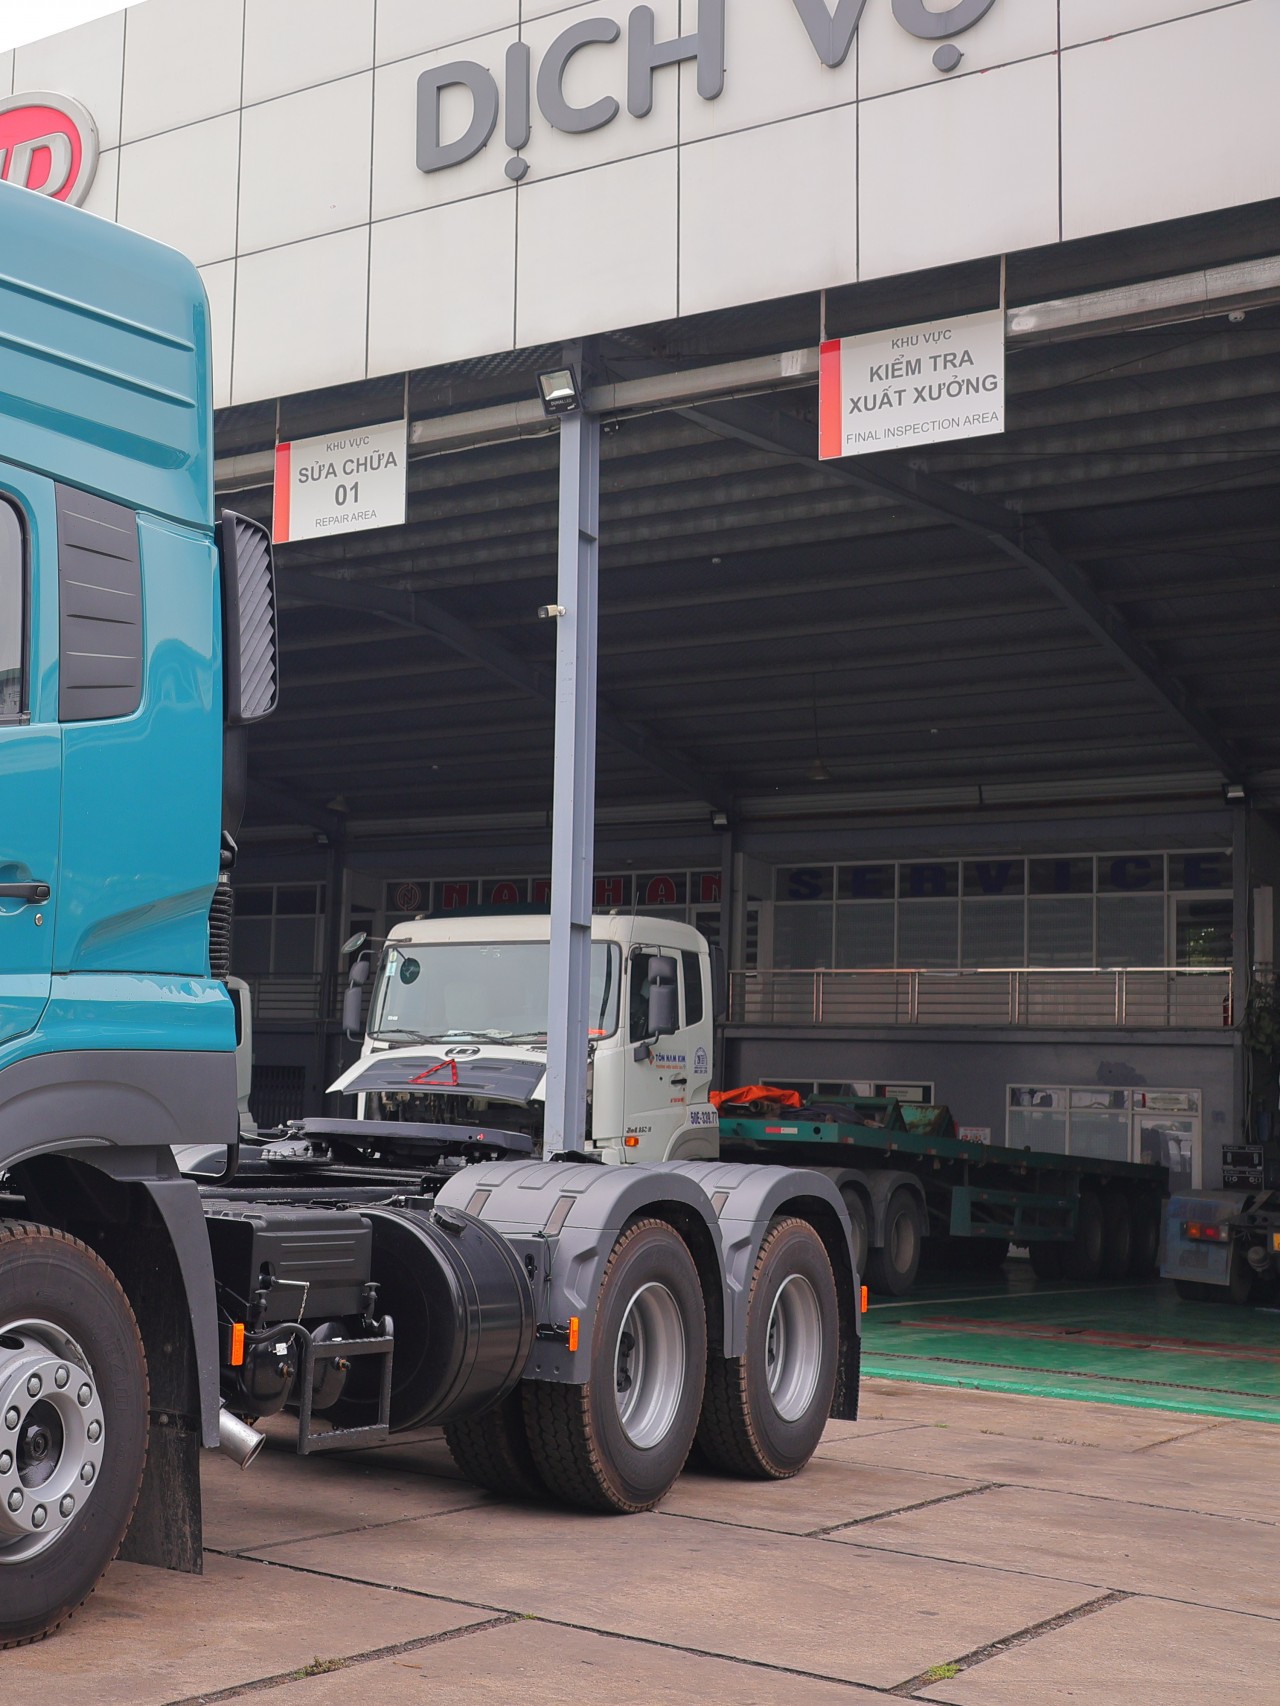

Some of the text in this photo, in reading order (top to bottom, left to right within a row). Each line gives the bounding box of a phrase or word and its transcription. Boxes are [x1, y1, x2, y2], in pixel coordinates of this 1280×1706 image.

[416, 0, 725, 181] DỊCH
[891, 329, 952, 349] KHU VỰC
[869, 349, 974, 382] KIỂM TRA
[848, 374, 998, 414] XUẤT XƯỞNG
[326, 436, 370, 452] KHU VỰC
[846, 411, 999, 445] FINAL INSPECTION AREA
[298, 449, 398, 484] SỬA CHỮA
[334, 481, 359, 506] 01
[315, 510, 377, 528] REPAIR AREA
[788, 854, 1223, 899] SERVICE
